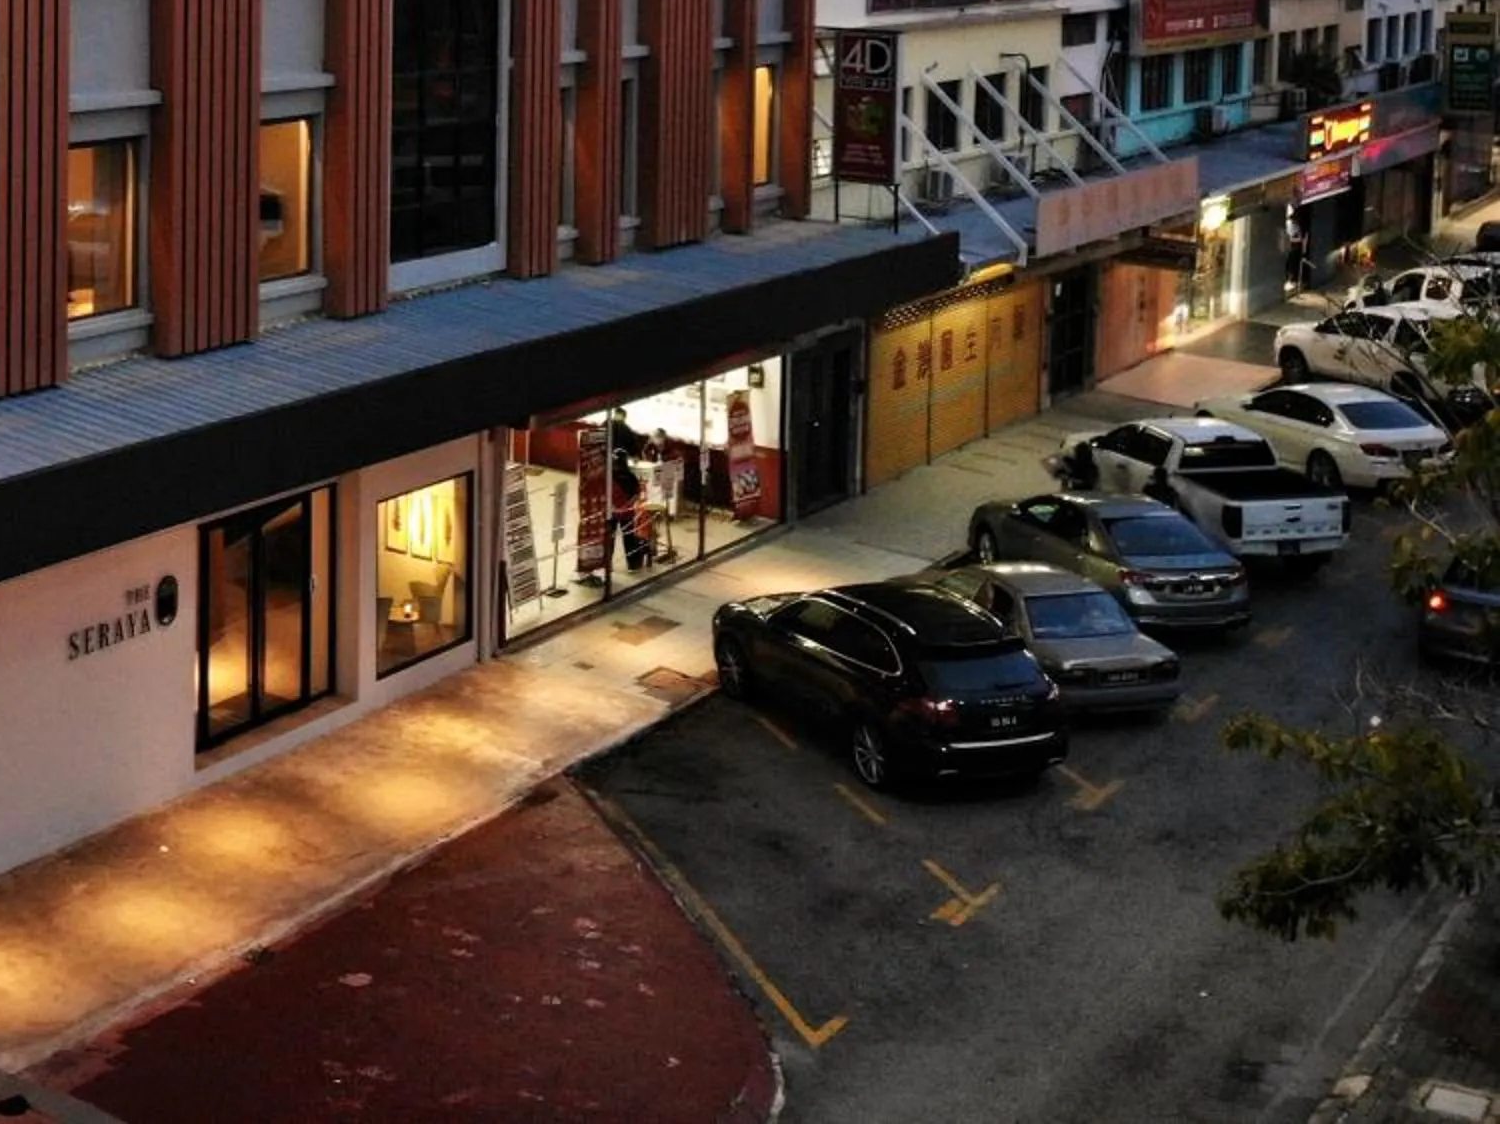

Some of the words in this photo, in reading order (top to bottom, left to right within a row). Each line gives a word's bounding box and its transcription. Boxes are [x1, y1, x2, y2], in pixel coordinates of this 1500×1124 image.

[842, 38, 892, 74] 4D
[126, 584, 150, 606] THE
[67, 607, 151, 661] SERAYA
